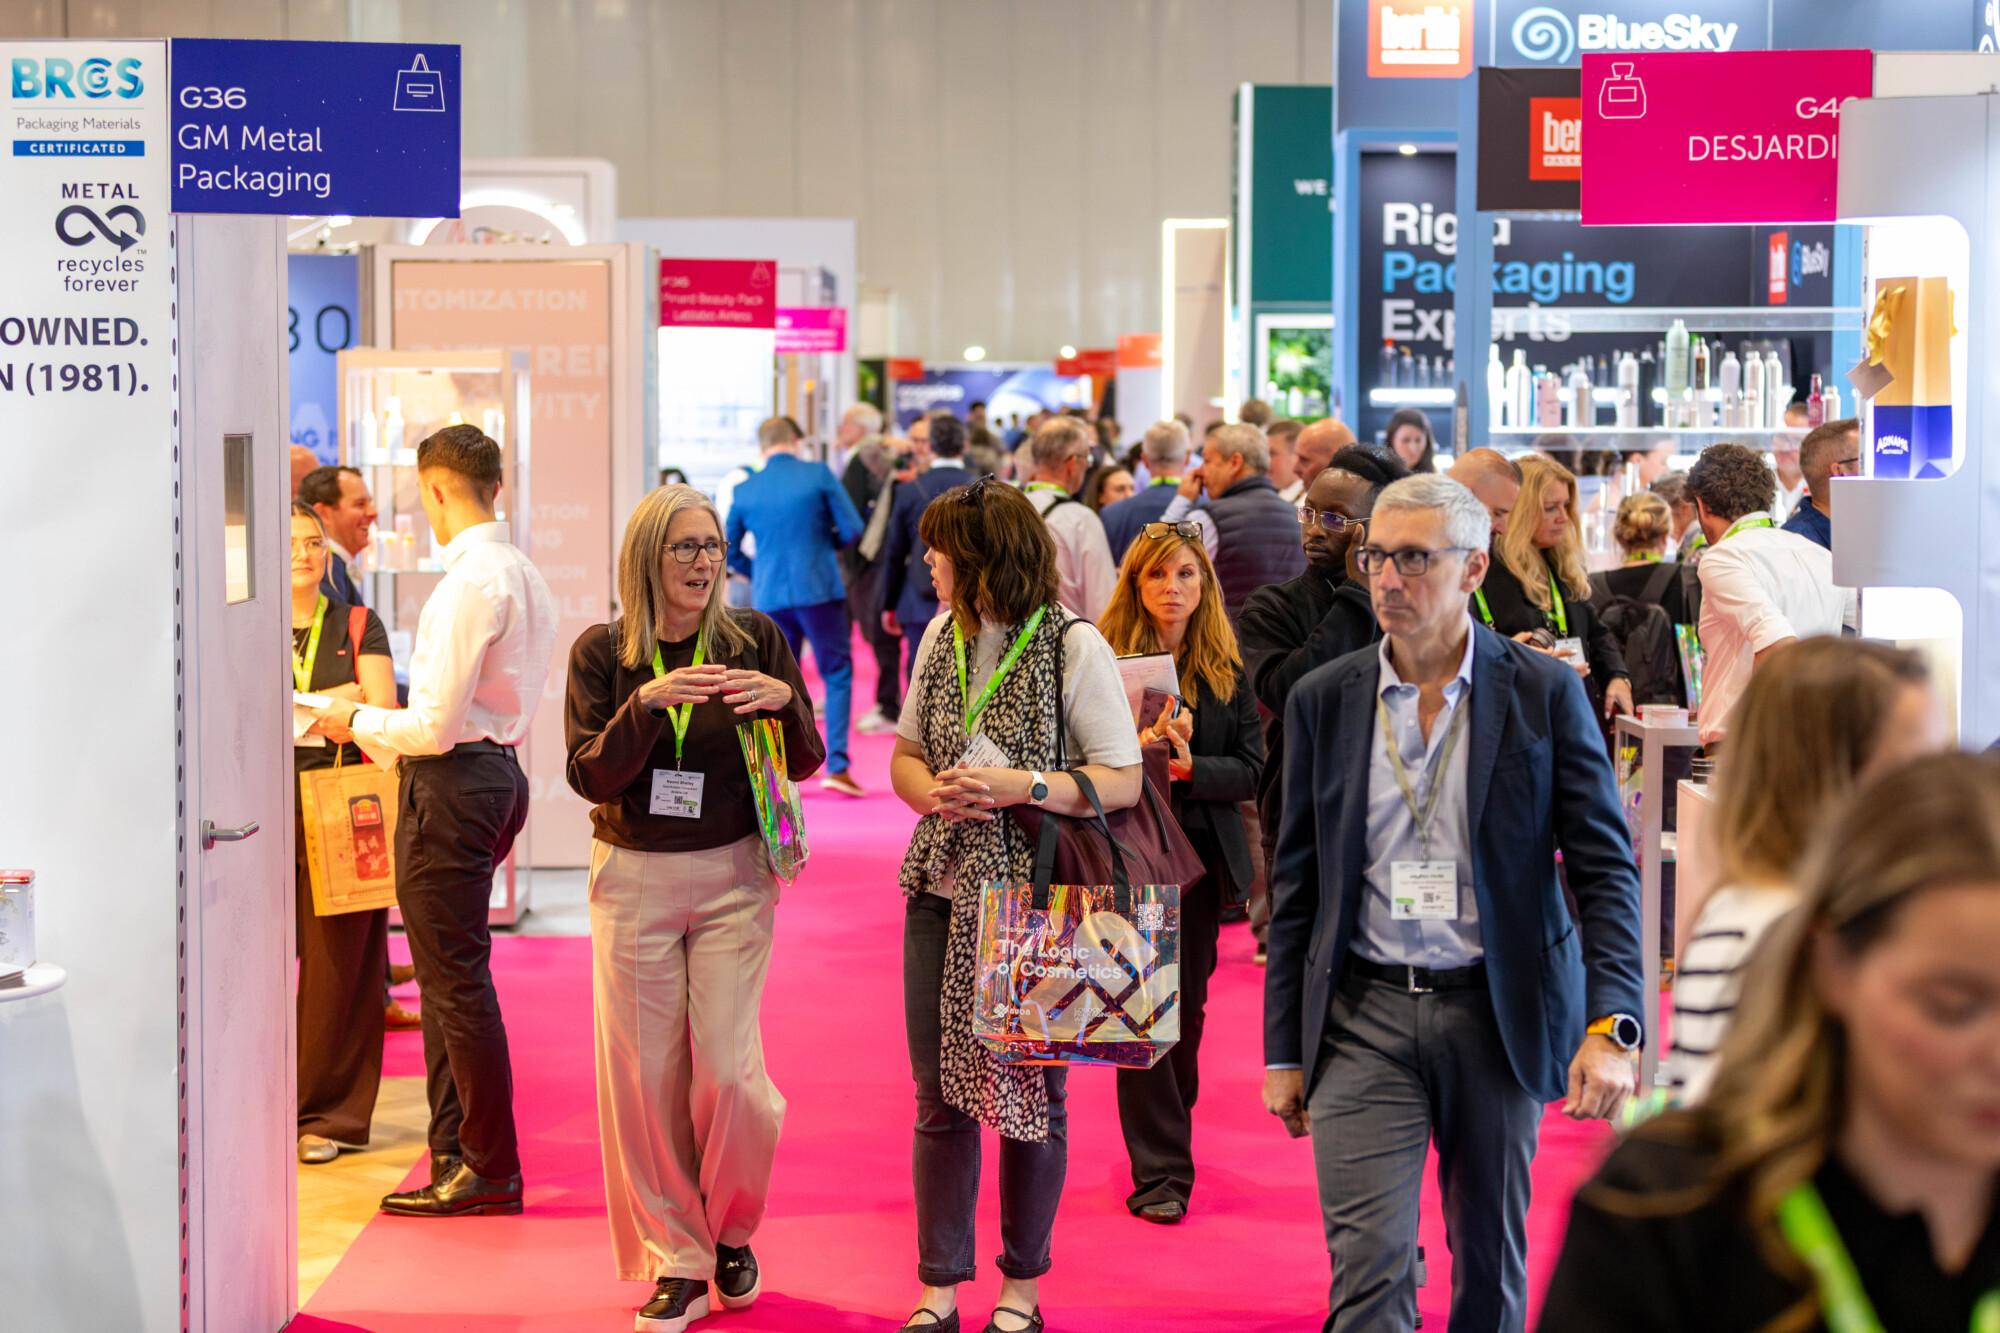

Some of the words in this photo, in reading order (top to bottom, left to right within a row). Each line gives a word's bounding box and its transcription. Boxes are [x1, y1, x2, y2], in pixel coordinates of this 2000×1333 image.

[1577, 13, 1739, 52] BlueSky
[179, 86, 247, 109] G36
[1795, 96, 1859, 119] G4
[16, 117, 79, 132] Packaging
[83, 117, 141, 129] Materials
[29, 143, 126, 154] CERTIFICATED
[178, 123, 229, 150] GM
[241, 125, 323, 152] Metal
[62, 183, 140, 199] METAL
[179, 163, 331, 199] Packaging
[57, 256, 145, 276] recycles
[1382, 250, 1636, 304] Paaging
[64, 275, 140, 292] forever
[0, 317, 148, 346] OWNED.
[26, 362, 149, 396] (1981).
[998, 940, 1034, 957] The
[1037, 943, 1090, 963] Logic
[997, 960, 1017, 976] of
[1020, 961, 1122, 980] Cosmetics
